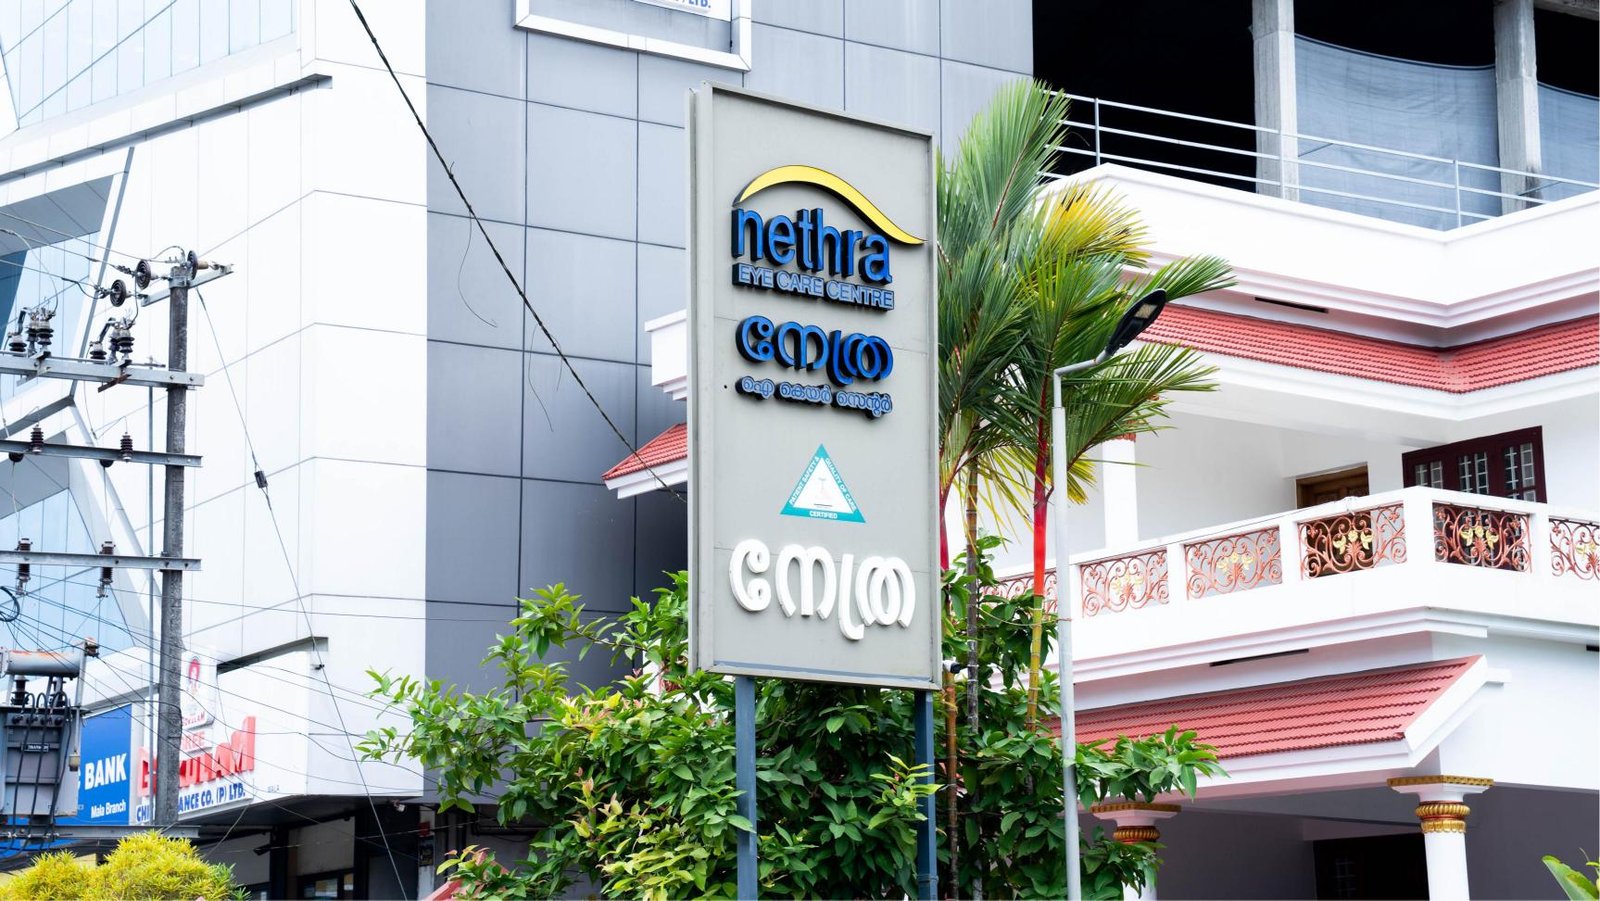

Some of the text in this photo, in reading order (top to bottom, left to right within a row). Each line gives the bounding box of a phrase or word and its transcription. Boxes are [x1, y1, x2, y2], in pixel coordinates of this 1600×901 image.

[732, 208, 892, 284] nethra
[733, 263, 894, 310] EYE CARE CENTRE
[736, 315, 893, 386] നേത്ര
[738, 376, 775, 398] ഐ
[809, 510, 838, 519] CERTIFIED
[729, 539, 916, 640] നേത്ര
[85, 753, 127, 790] BANK
[91, 799, 126, 818] Mala Branch
[178, 793, 199, 812] ANCE
[201, 791, 214, 806] CO.
[216, 785, 227, 803] (P)
[229, 782, 246, 800] LTD.
